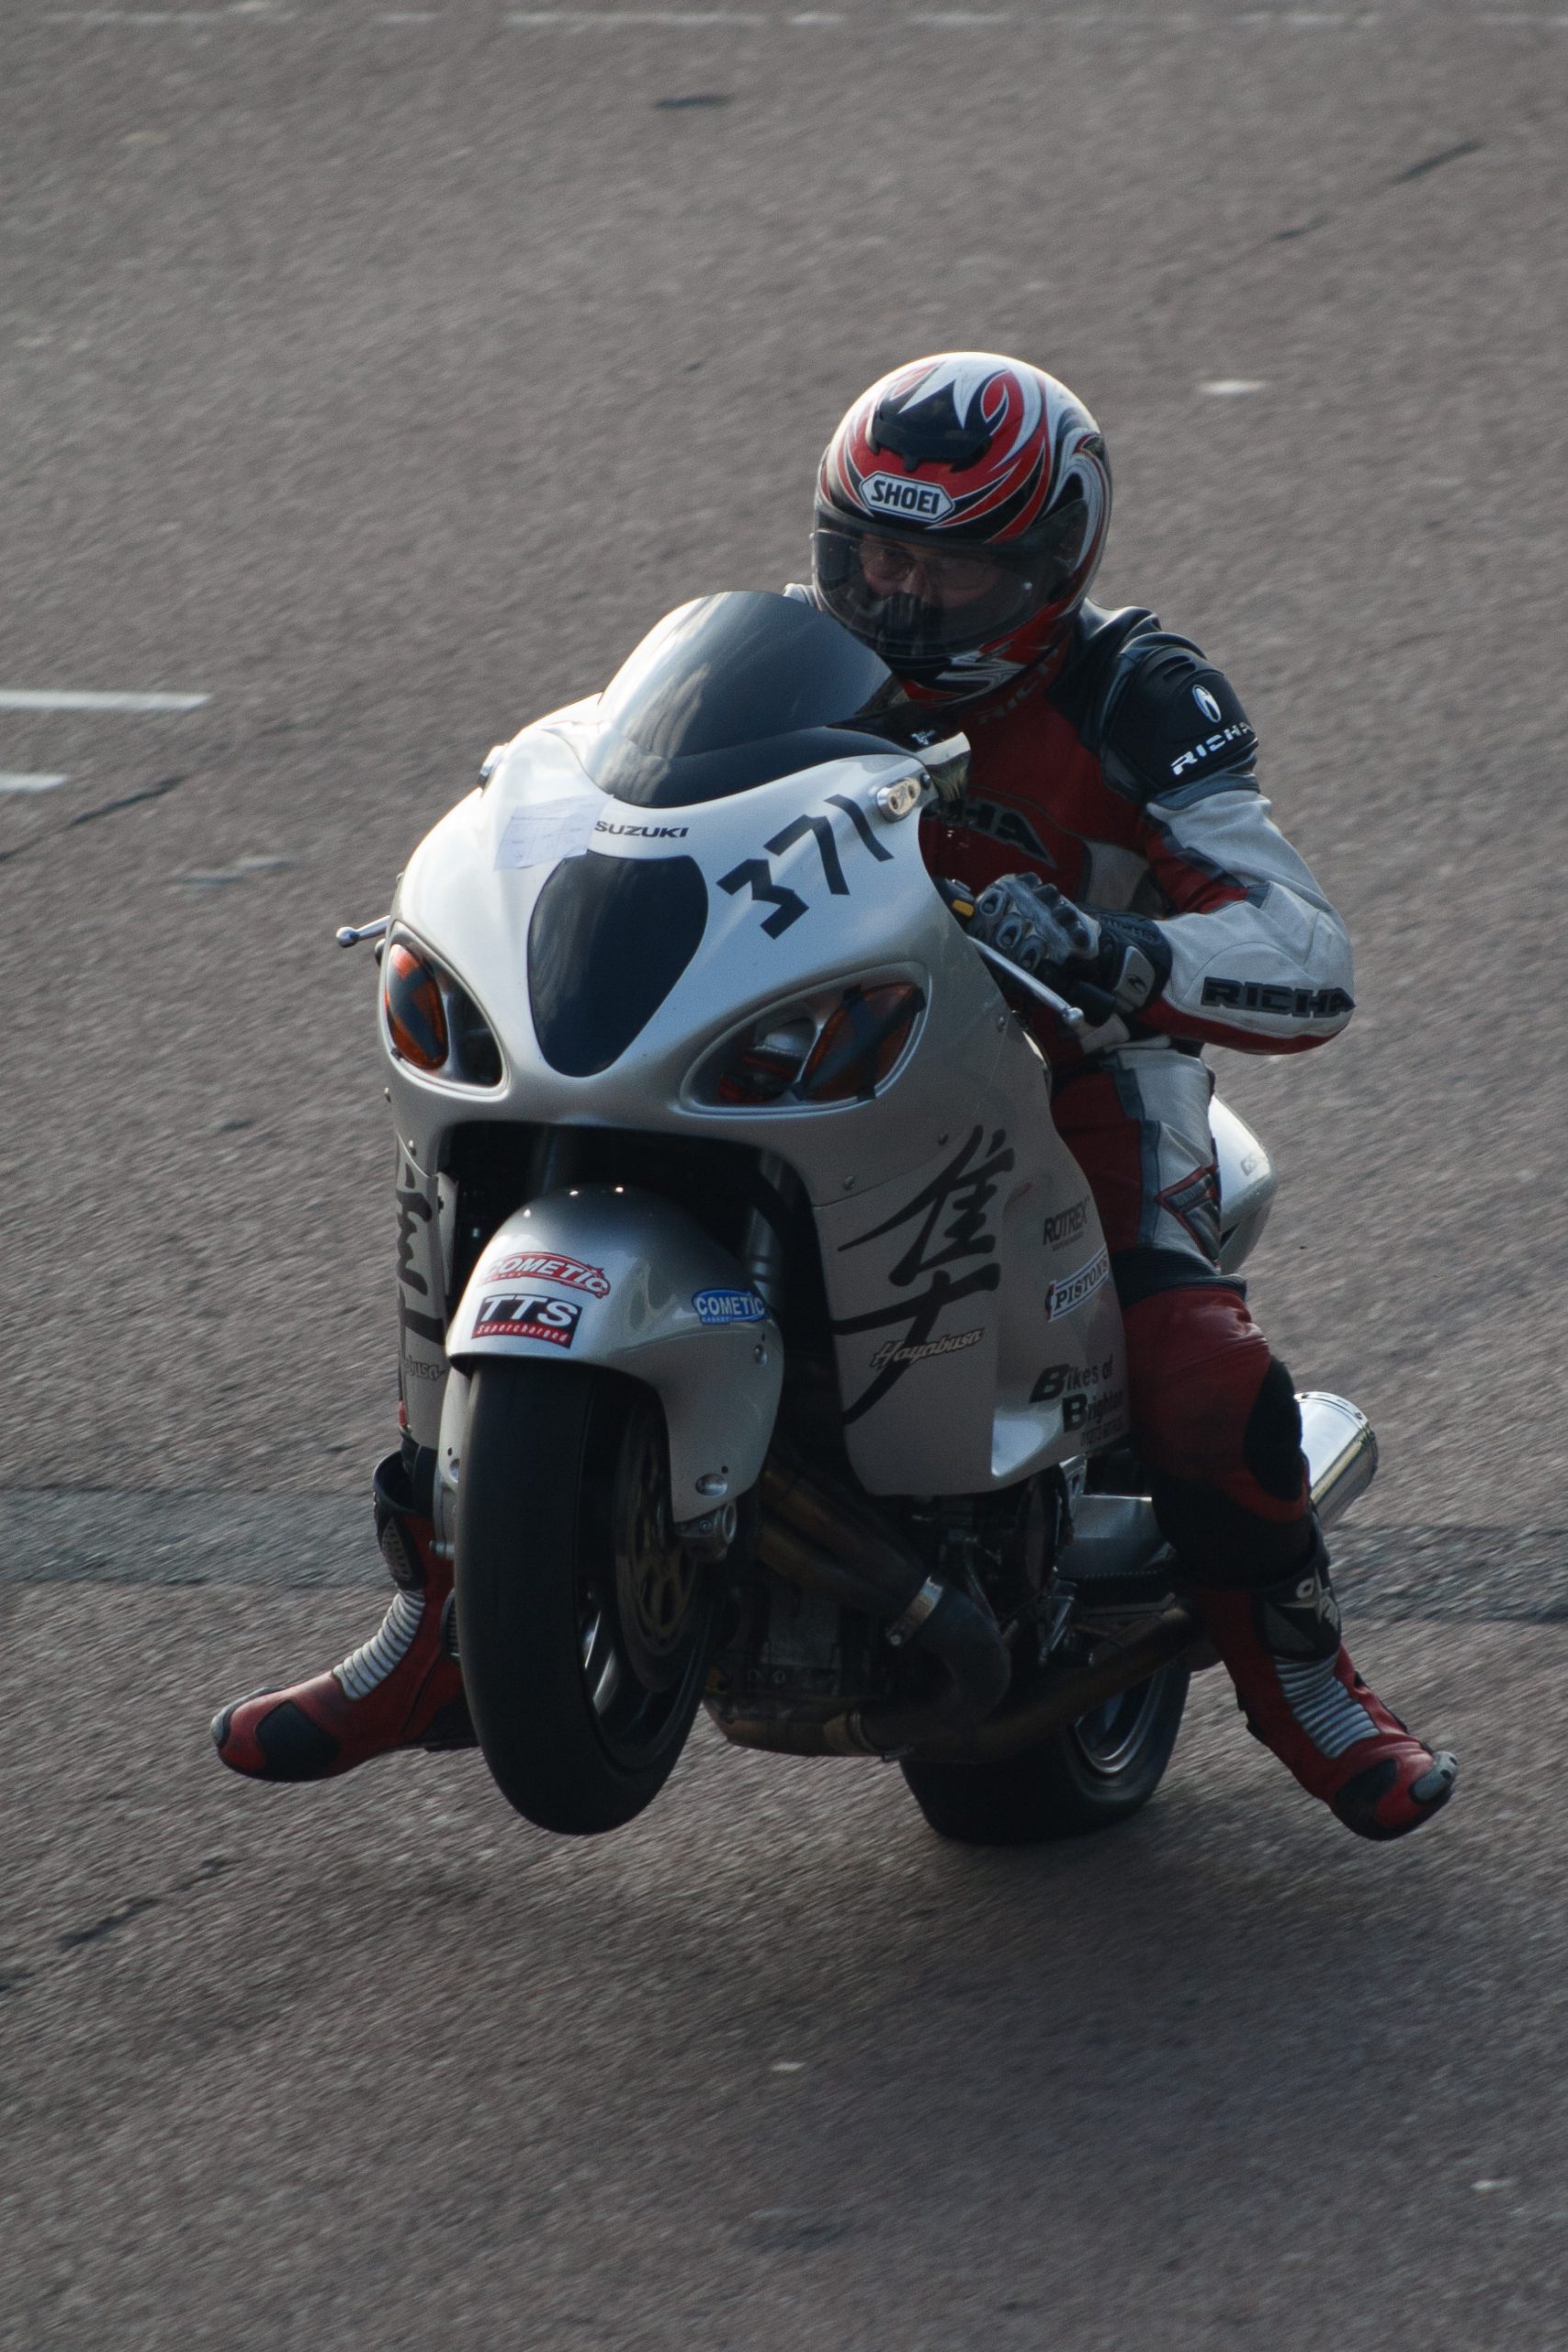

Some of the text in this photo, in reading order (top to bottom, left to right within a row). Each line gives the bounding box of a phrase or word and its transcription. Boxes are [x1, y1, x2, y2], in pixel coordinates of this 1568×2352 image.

[871, 480, 941, 514] SHOEI
[1170, 721, 1256, 775] RICHA
[594, 820, 690, 838] SUZUKI
[716, 794, 895, 940] 371
[1201, 977, 1356, 1018] RICHA
[1043, 1200, 1088, 1246] ROTREX
[484, 1257, 608, 1293] COMETIC
[1054, 1255, 1109, 1311] PISTONS
[480, 1295, 579, 1328] TTS
[696, 1295, 766, 1316] COMETIC
[477, 1323, 569, 1342] Supercharged
[870, 1328, 986, 1370] Hayabusa
[1029, 1353, 1113, 1404] Bikes of
